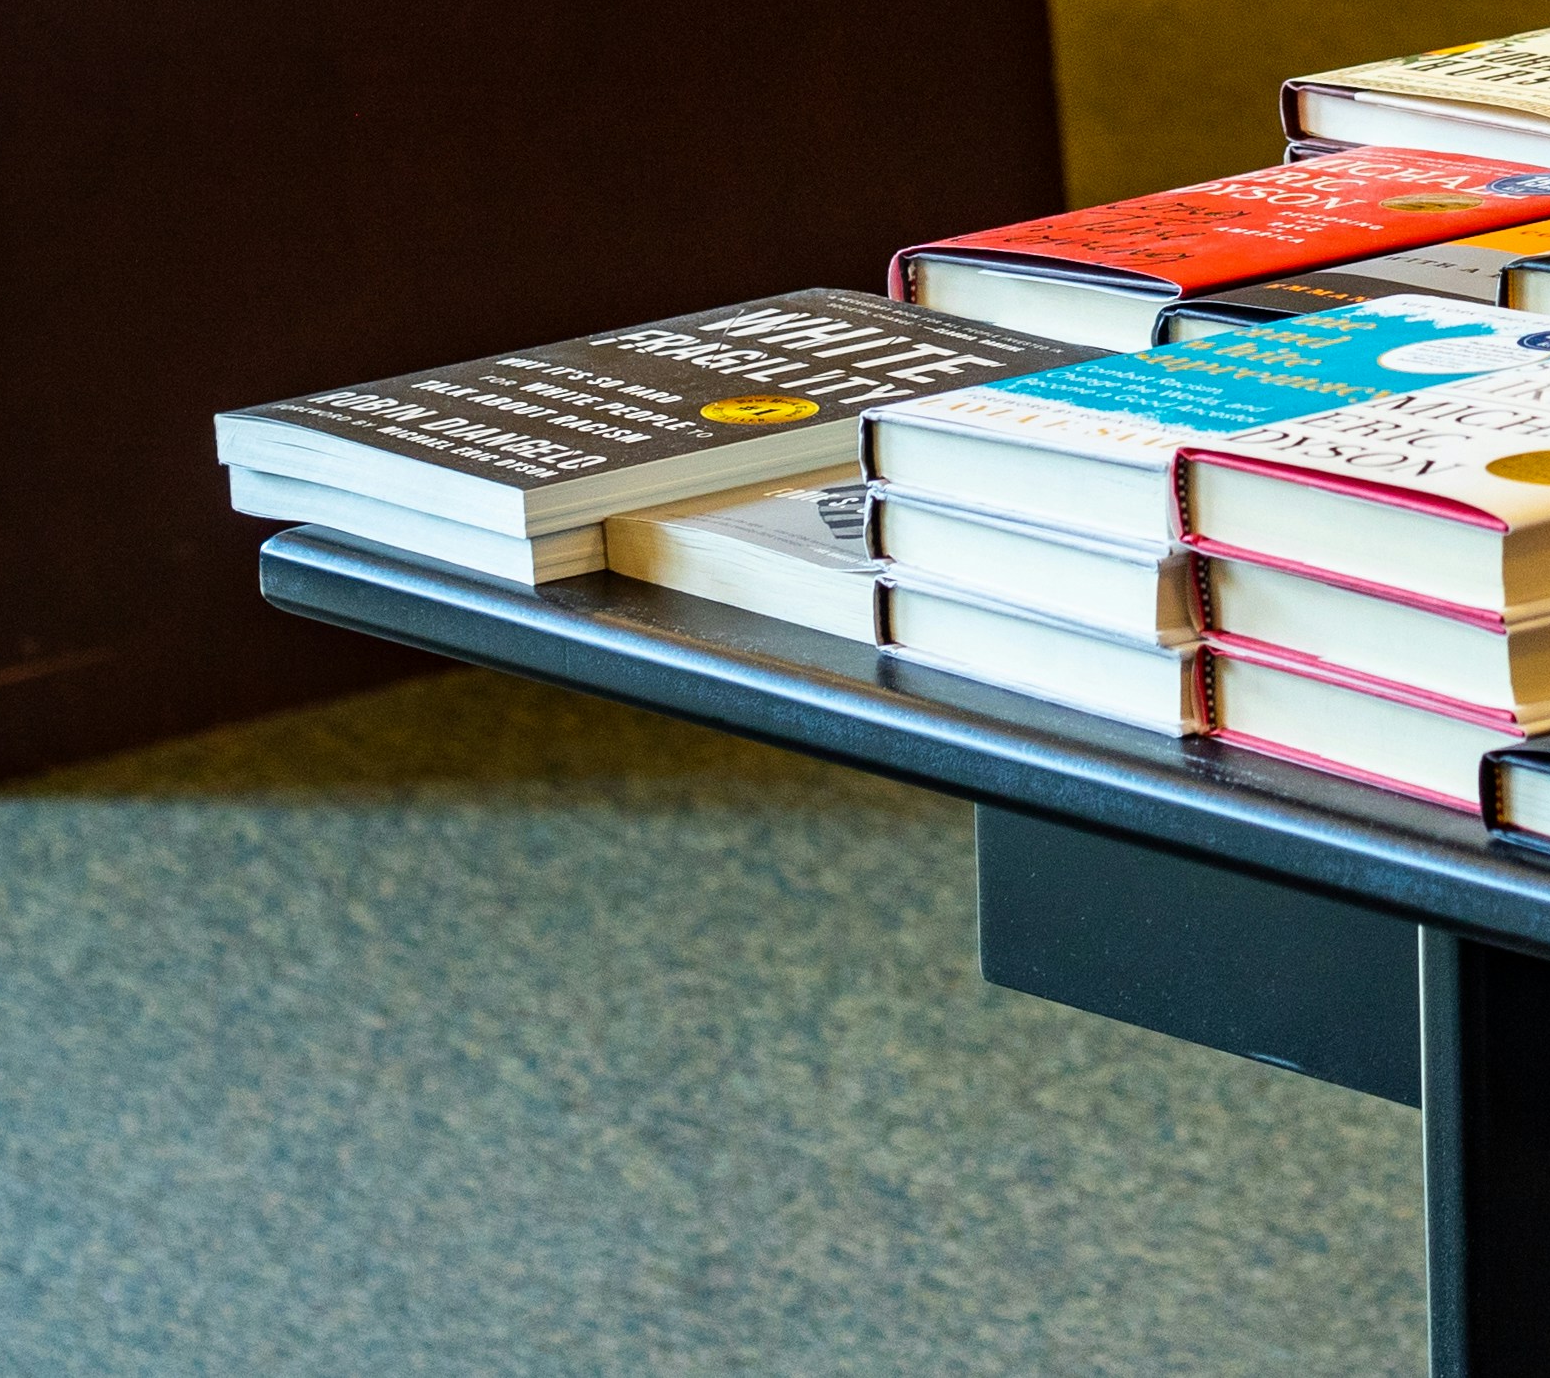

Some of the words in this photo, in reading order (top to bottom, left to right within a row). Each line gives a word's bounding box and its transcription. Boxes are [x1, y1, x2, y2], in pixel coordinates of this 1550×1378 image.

[1182, 181, 1368, 211] DYSON
[1213, 226, 1306, 244] AMERICA
[589, 329, 916, 405] FRAGILITY
[699, 307, 1007, 384] WHITE
[478, 375, 516, 387] FOR
[519, 381, 600, 408] WHITE
[595, 397, 696, 432] PEOPLE
[495, 357, 549, 376] WHY
[550, 362, 587, 382] IT'S
[588, 371, 623, 388] SO
[623, 379, 683, 404] HARD
[307, 391, 428, 424] ROBIN
[422, 415, 608, 471] DIANGELO
[411, 380, 470, 404] TALK
[471, 389, 557, 419] ABOUT
[549, 415, 653, 445] RACISM
[1298, 411, 1472, 449] ERIC
[272, 403, 351, 422] FOREWORD
[349, 417, 374, 428] BY
[376, 424, 452, 452] MICHAEL
[451, 445, 503, 464] ERIC
[496, 457, 560, 480] DYSON
[1226, 428, 1469, 478] DYSON
